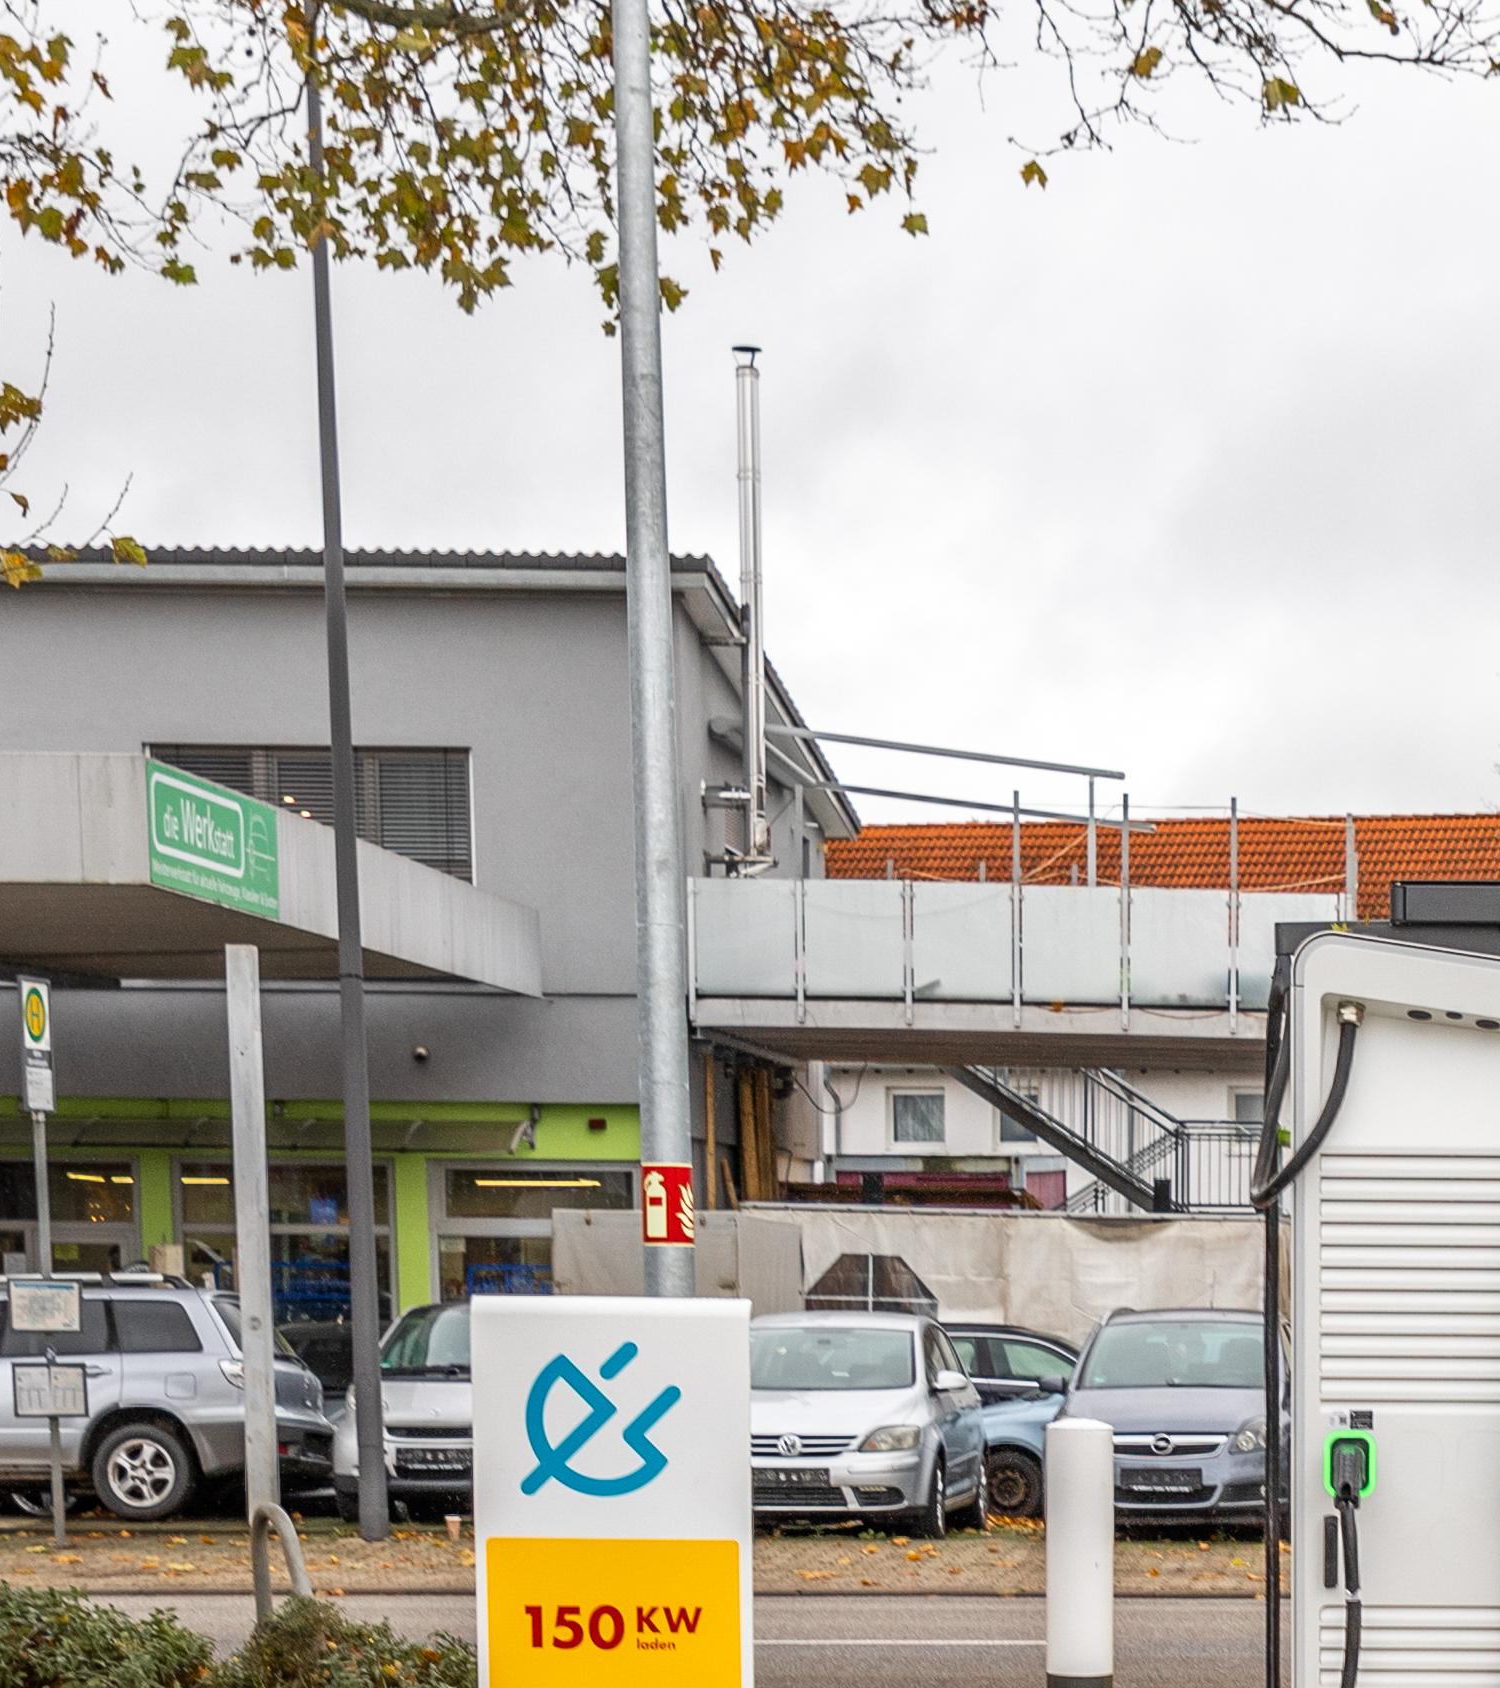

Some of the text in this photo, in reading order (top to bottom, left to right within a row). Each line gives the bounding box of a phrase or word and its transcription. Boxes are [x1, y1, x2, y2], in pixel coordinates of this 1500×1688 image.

[163, 798, 235, 859] die Werkstatt
[524, 1604, 702, 1650] 150 KW
[636, 1638, 676, 1650] laden
